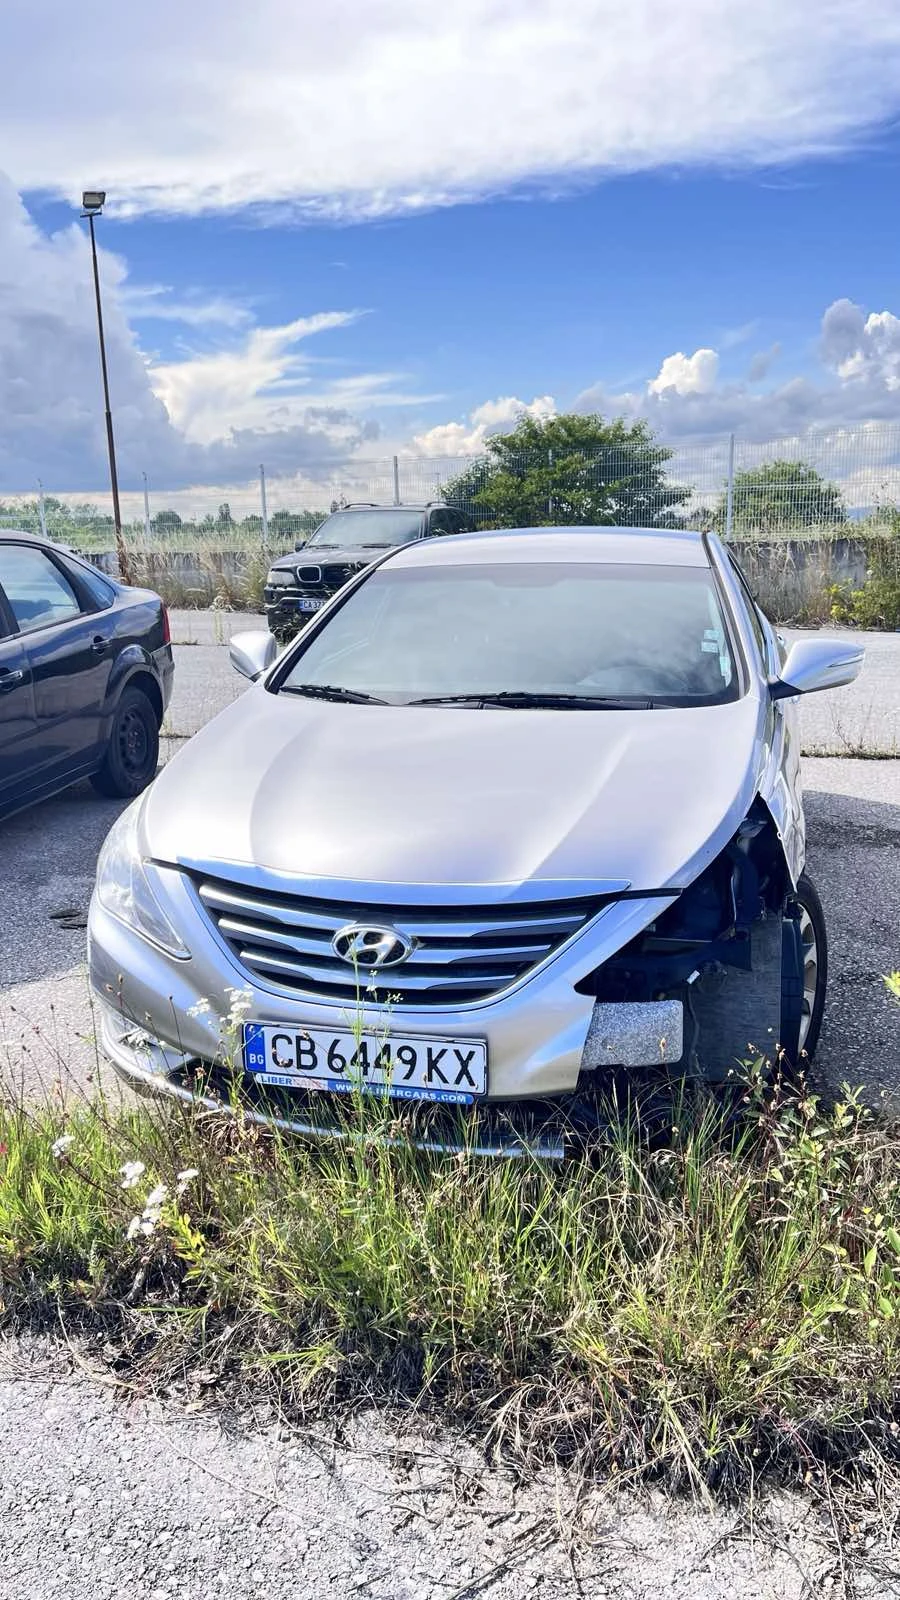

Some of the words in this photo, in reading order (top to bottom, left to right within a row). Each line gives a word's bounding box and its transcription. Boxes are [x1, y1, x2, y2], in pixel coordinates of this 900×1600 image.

[249, 1053, 265, 1065] BG
[271, 1033, 318, 1071] CB
[327, 1038, 418, 1081] 6449
[426, 1046, 476, 1087] KX
